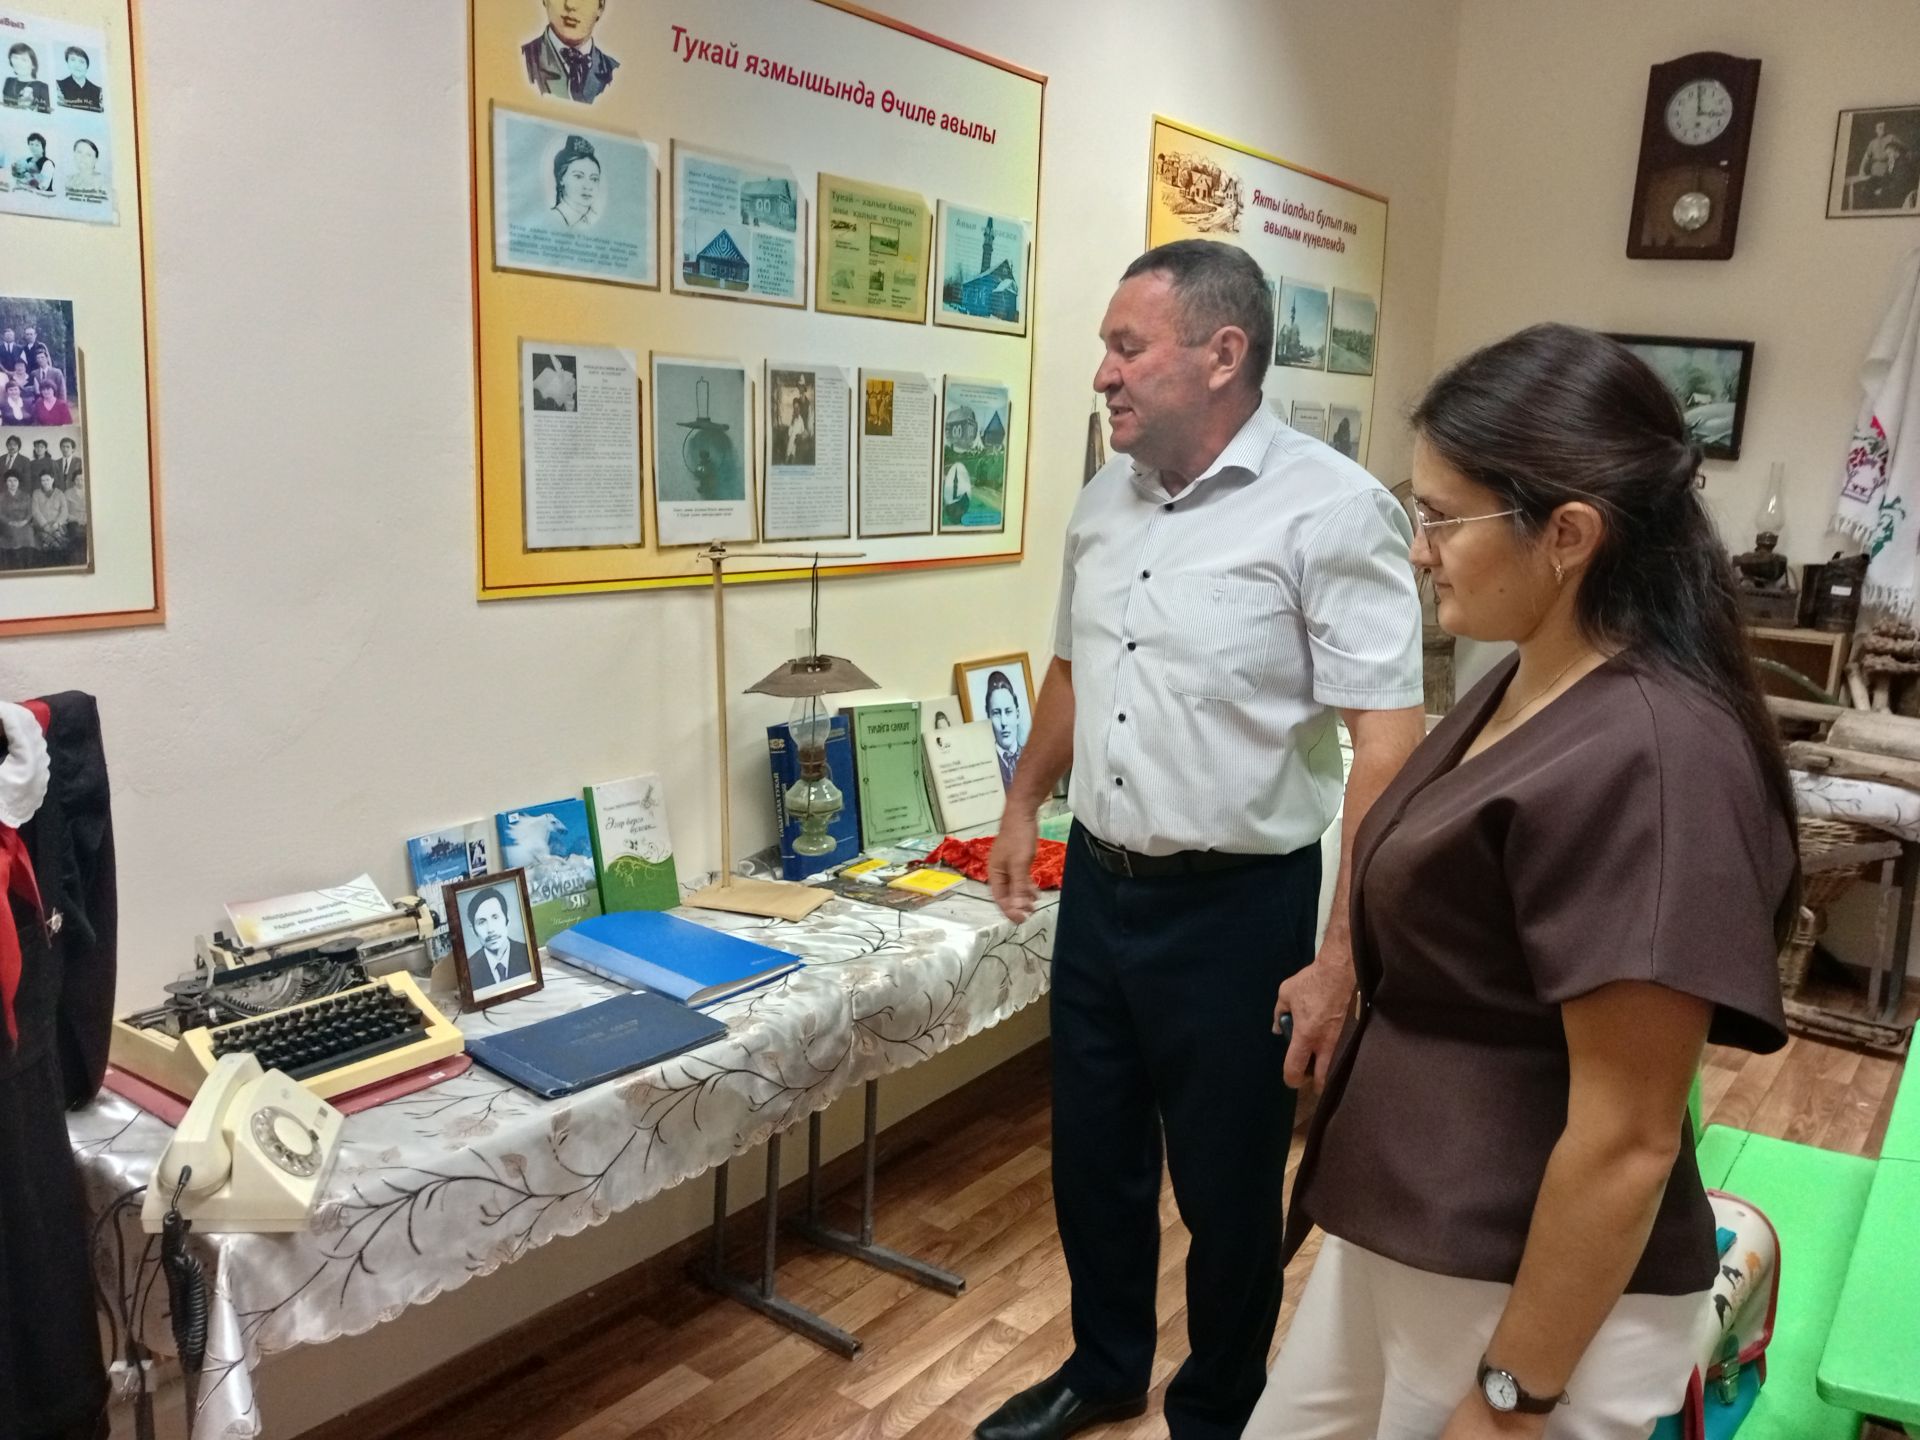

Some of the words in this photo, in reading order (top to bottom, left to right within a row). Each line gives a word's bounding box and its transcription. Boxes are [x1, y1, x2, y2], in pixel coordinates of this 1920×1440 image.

[671, 24, 739, 69] Тукай
[744, 54, 875, 108] язмышында
[881, 90, 936, 126] Өчиле
[940, 113, 997, 145] авылы
[1252, 189, 1281, 213] Якты
[1282, 198, 1315, 222] йолдыз
[1316, 209, 1342, 232] булып
[1343, 220, 1358, 235] яна
[1263, 220, 1302, 242] авылым
